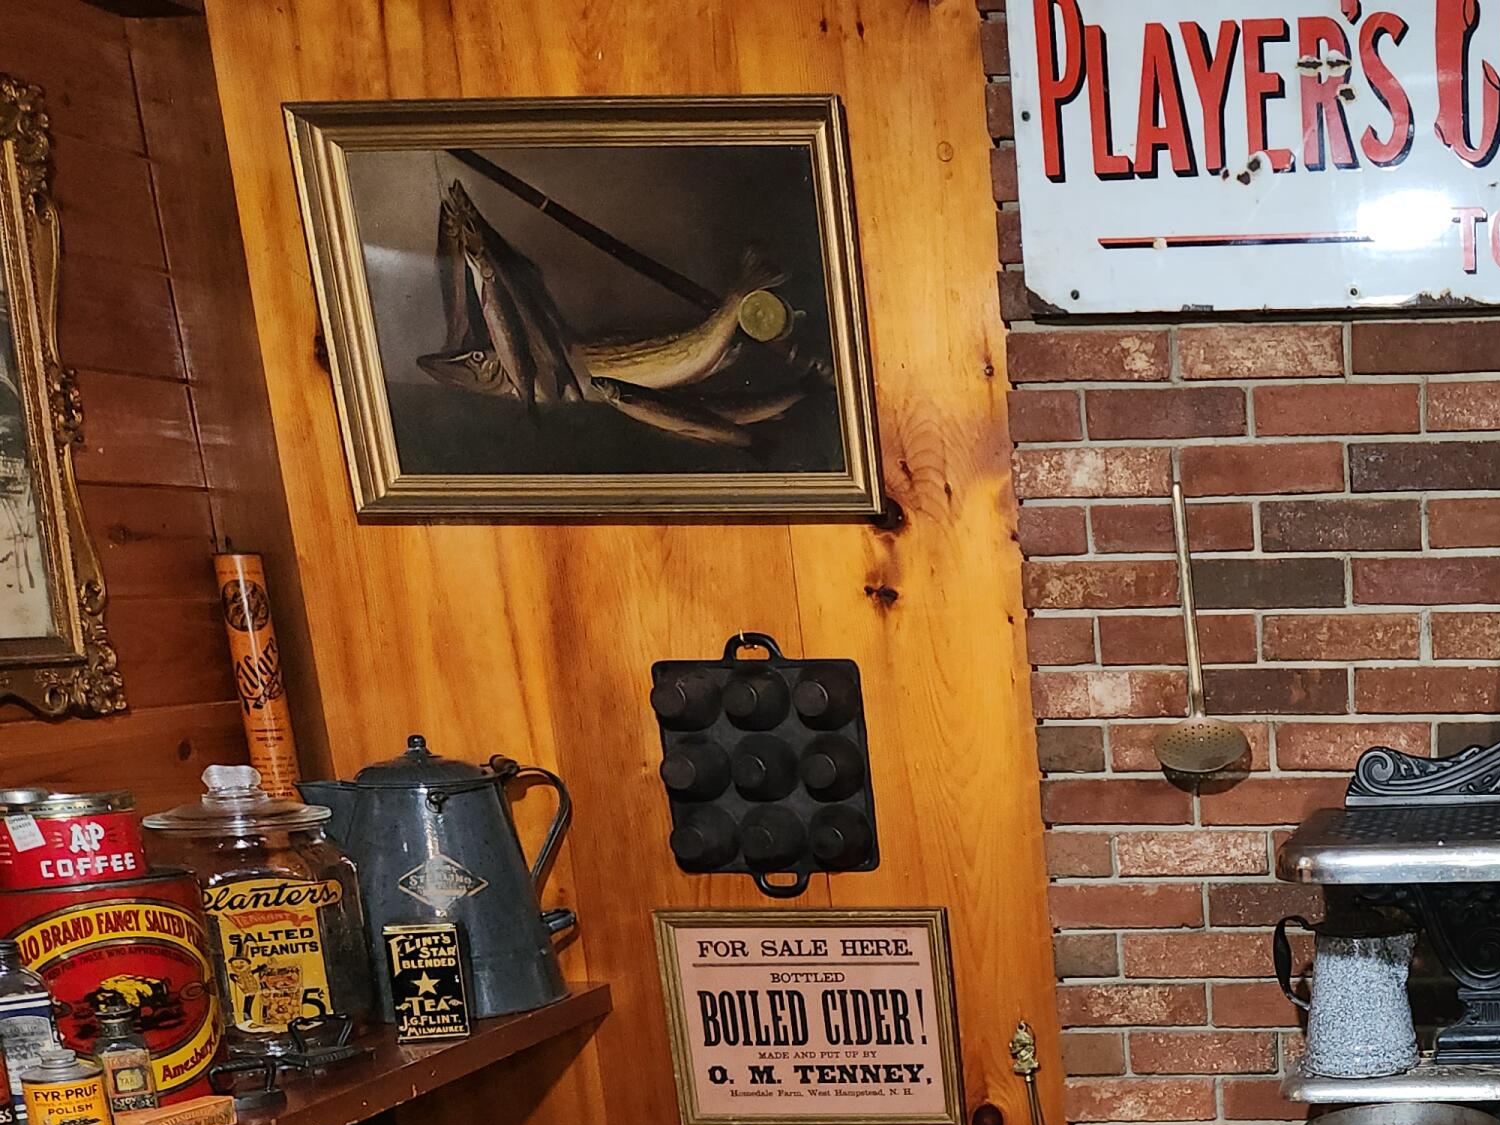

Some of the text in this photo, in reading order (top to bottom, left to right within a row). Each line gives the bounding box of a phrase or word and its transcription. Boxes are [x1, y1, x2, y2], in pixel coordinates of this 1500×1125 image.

[1033, 0, 1415, 183] PLAYER'S
[40, 852, 136, 878] COFFEE
[40, 917, 94, 952] BRAND
[145, 909, 186, 939] SALTED
[228, 928, 314, 946] SALTED
[251, 941, 319, 957] PEANUTS
[388, 933, 452, 978] FLINT'S
[419, 947, 457, 959] STAR
[697, 939, 913, 957] FOR SALE HERE.
[402, 957, 457, 970] BLENDED
[770, 972, 845, 984] BOTTLED
[405, 995, 452, 1016] TEA
[697, 988, 928, 1047] BOILED CIDER!
[407, 1024, 465, 1037] MILWAUKEE
[758, 1051, 877, 1060] MADE AND PUT UP BY
[707, 1063, 933, 1085] O. M. TENNEY,
[34, 1084, 98, 1102] FYR-PRUF
[808, 1088, 831, 1098] West
[889, 1088, 899, 1097] N.
[903, 1088, 914, 1097] H.
[48, 1103, 94, 1116] POLISH
